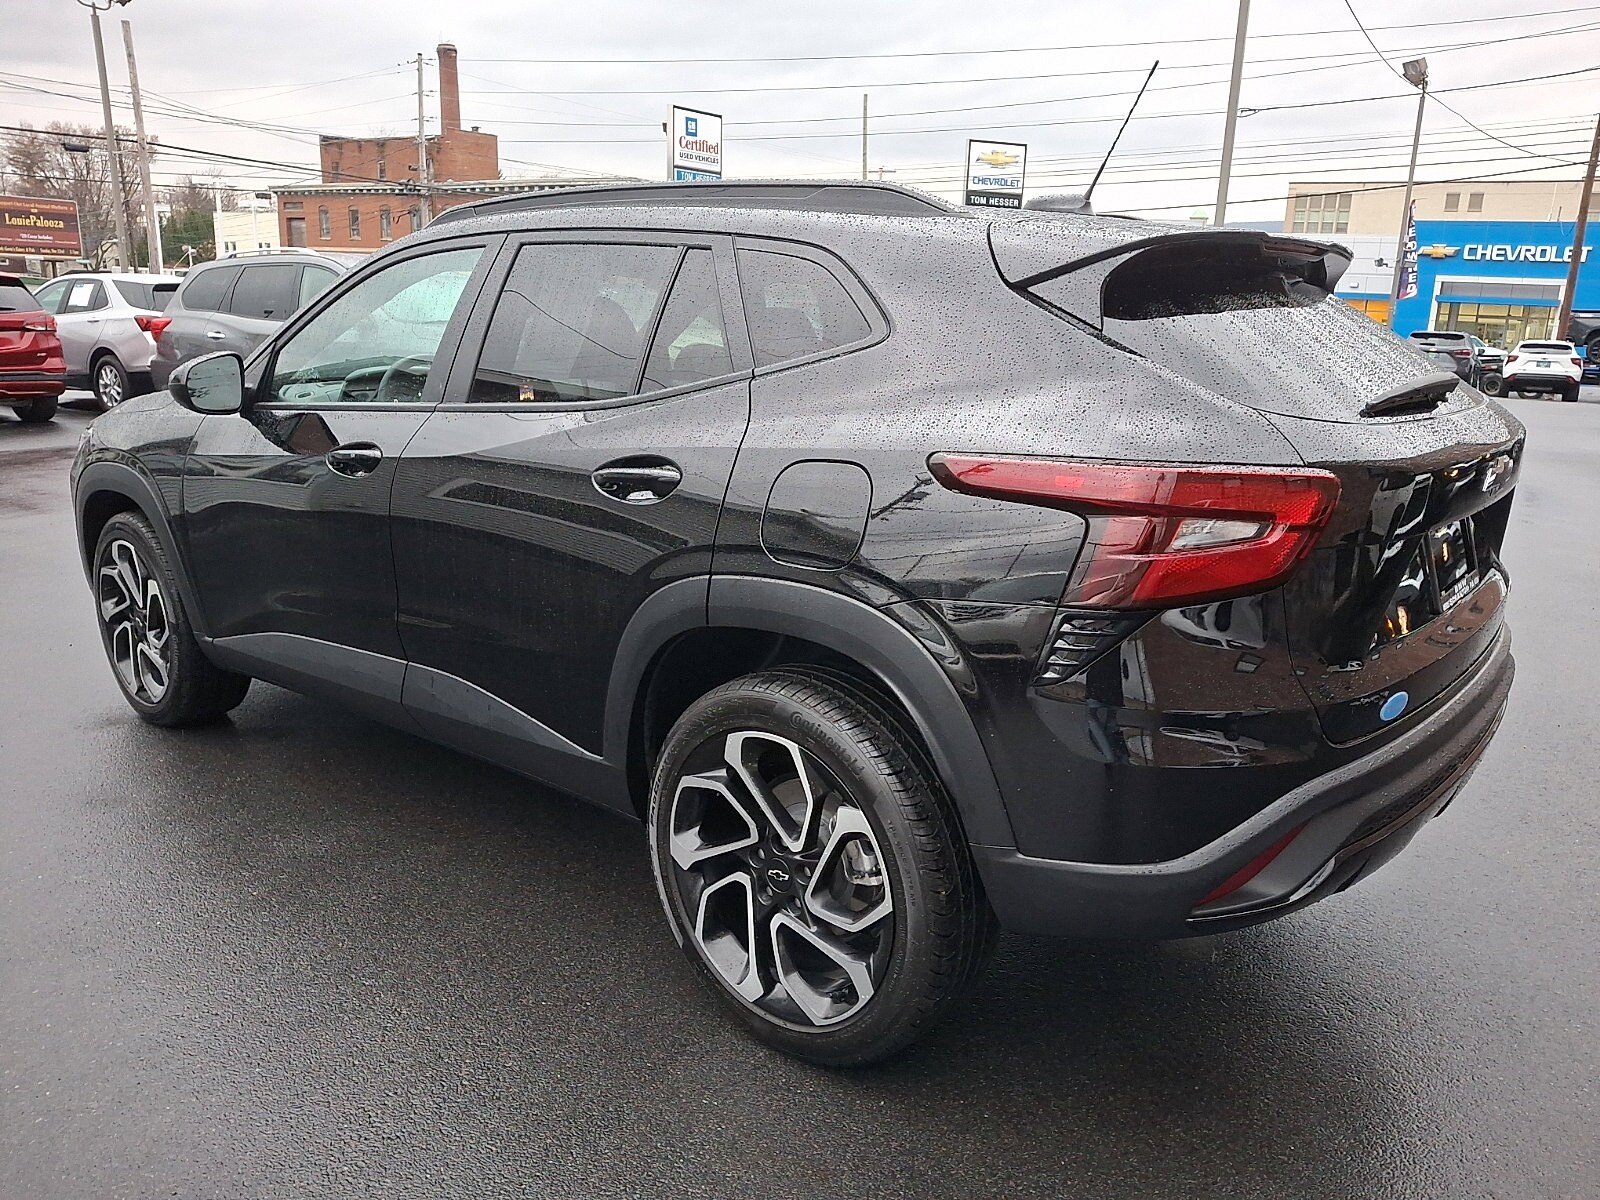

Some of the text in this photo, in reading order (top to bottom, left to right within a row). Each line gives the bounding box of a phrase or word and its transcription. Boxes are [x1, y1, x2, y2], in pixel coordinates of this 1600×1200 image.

[679, 136, 719, 154] Certified
[680, 152, 719, 164] USED VEHICLES
[681, 171, 694, 182] TOM
[972, 176, 1020, 187] CHEVROLET
[970, 196, 1019, 207] TOM HESSER
[5, 213, 64, 228] LouiePalooza
[1463, 244, 1593, 263] CHEVROLET
